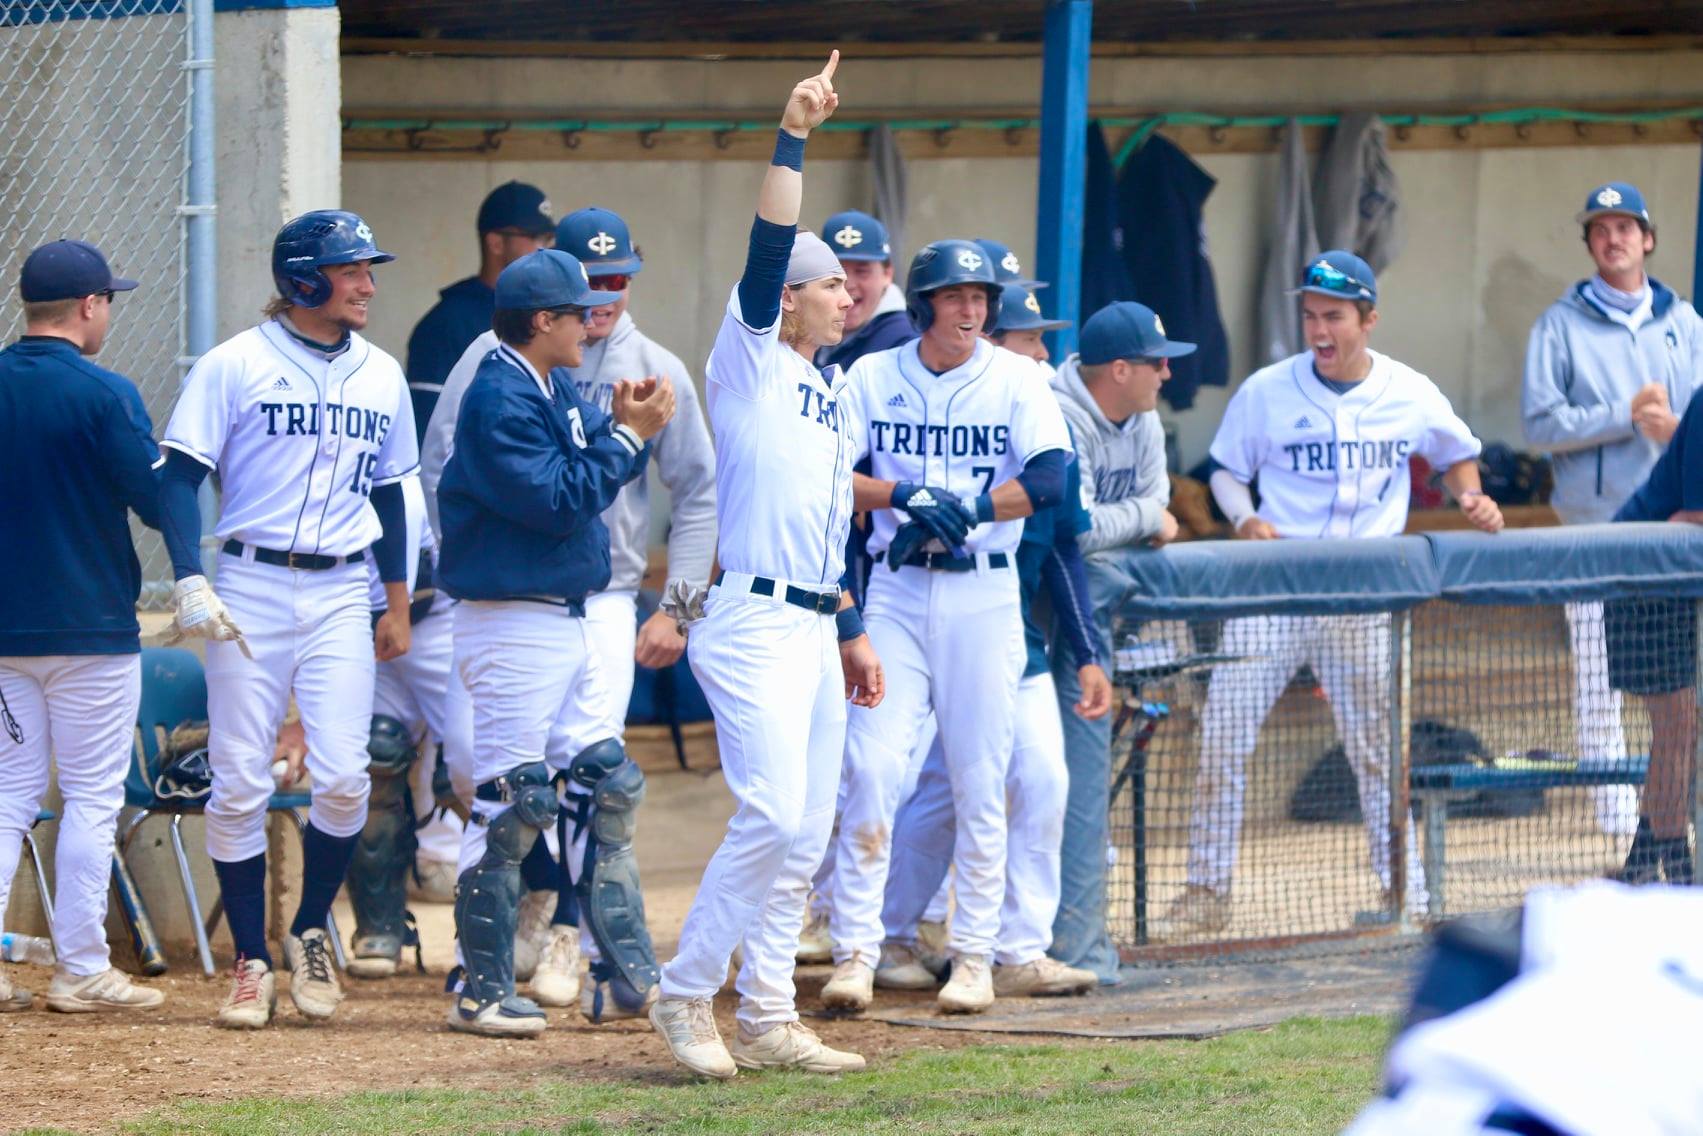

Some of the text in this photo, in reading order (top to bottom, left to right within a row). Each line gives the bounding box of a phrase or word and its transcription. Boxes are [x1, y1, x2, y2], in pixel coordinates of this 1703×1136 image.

[261, 402, 391, 446] TRITONS
[871, 420, 1009, 456] TRITONS
[1283, 440, 1409, 471] TRITONS
[971, 466, 995, 498] 7
